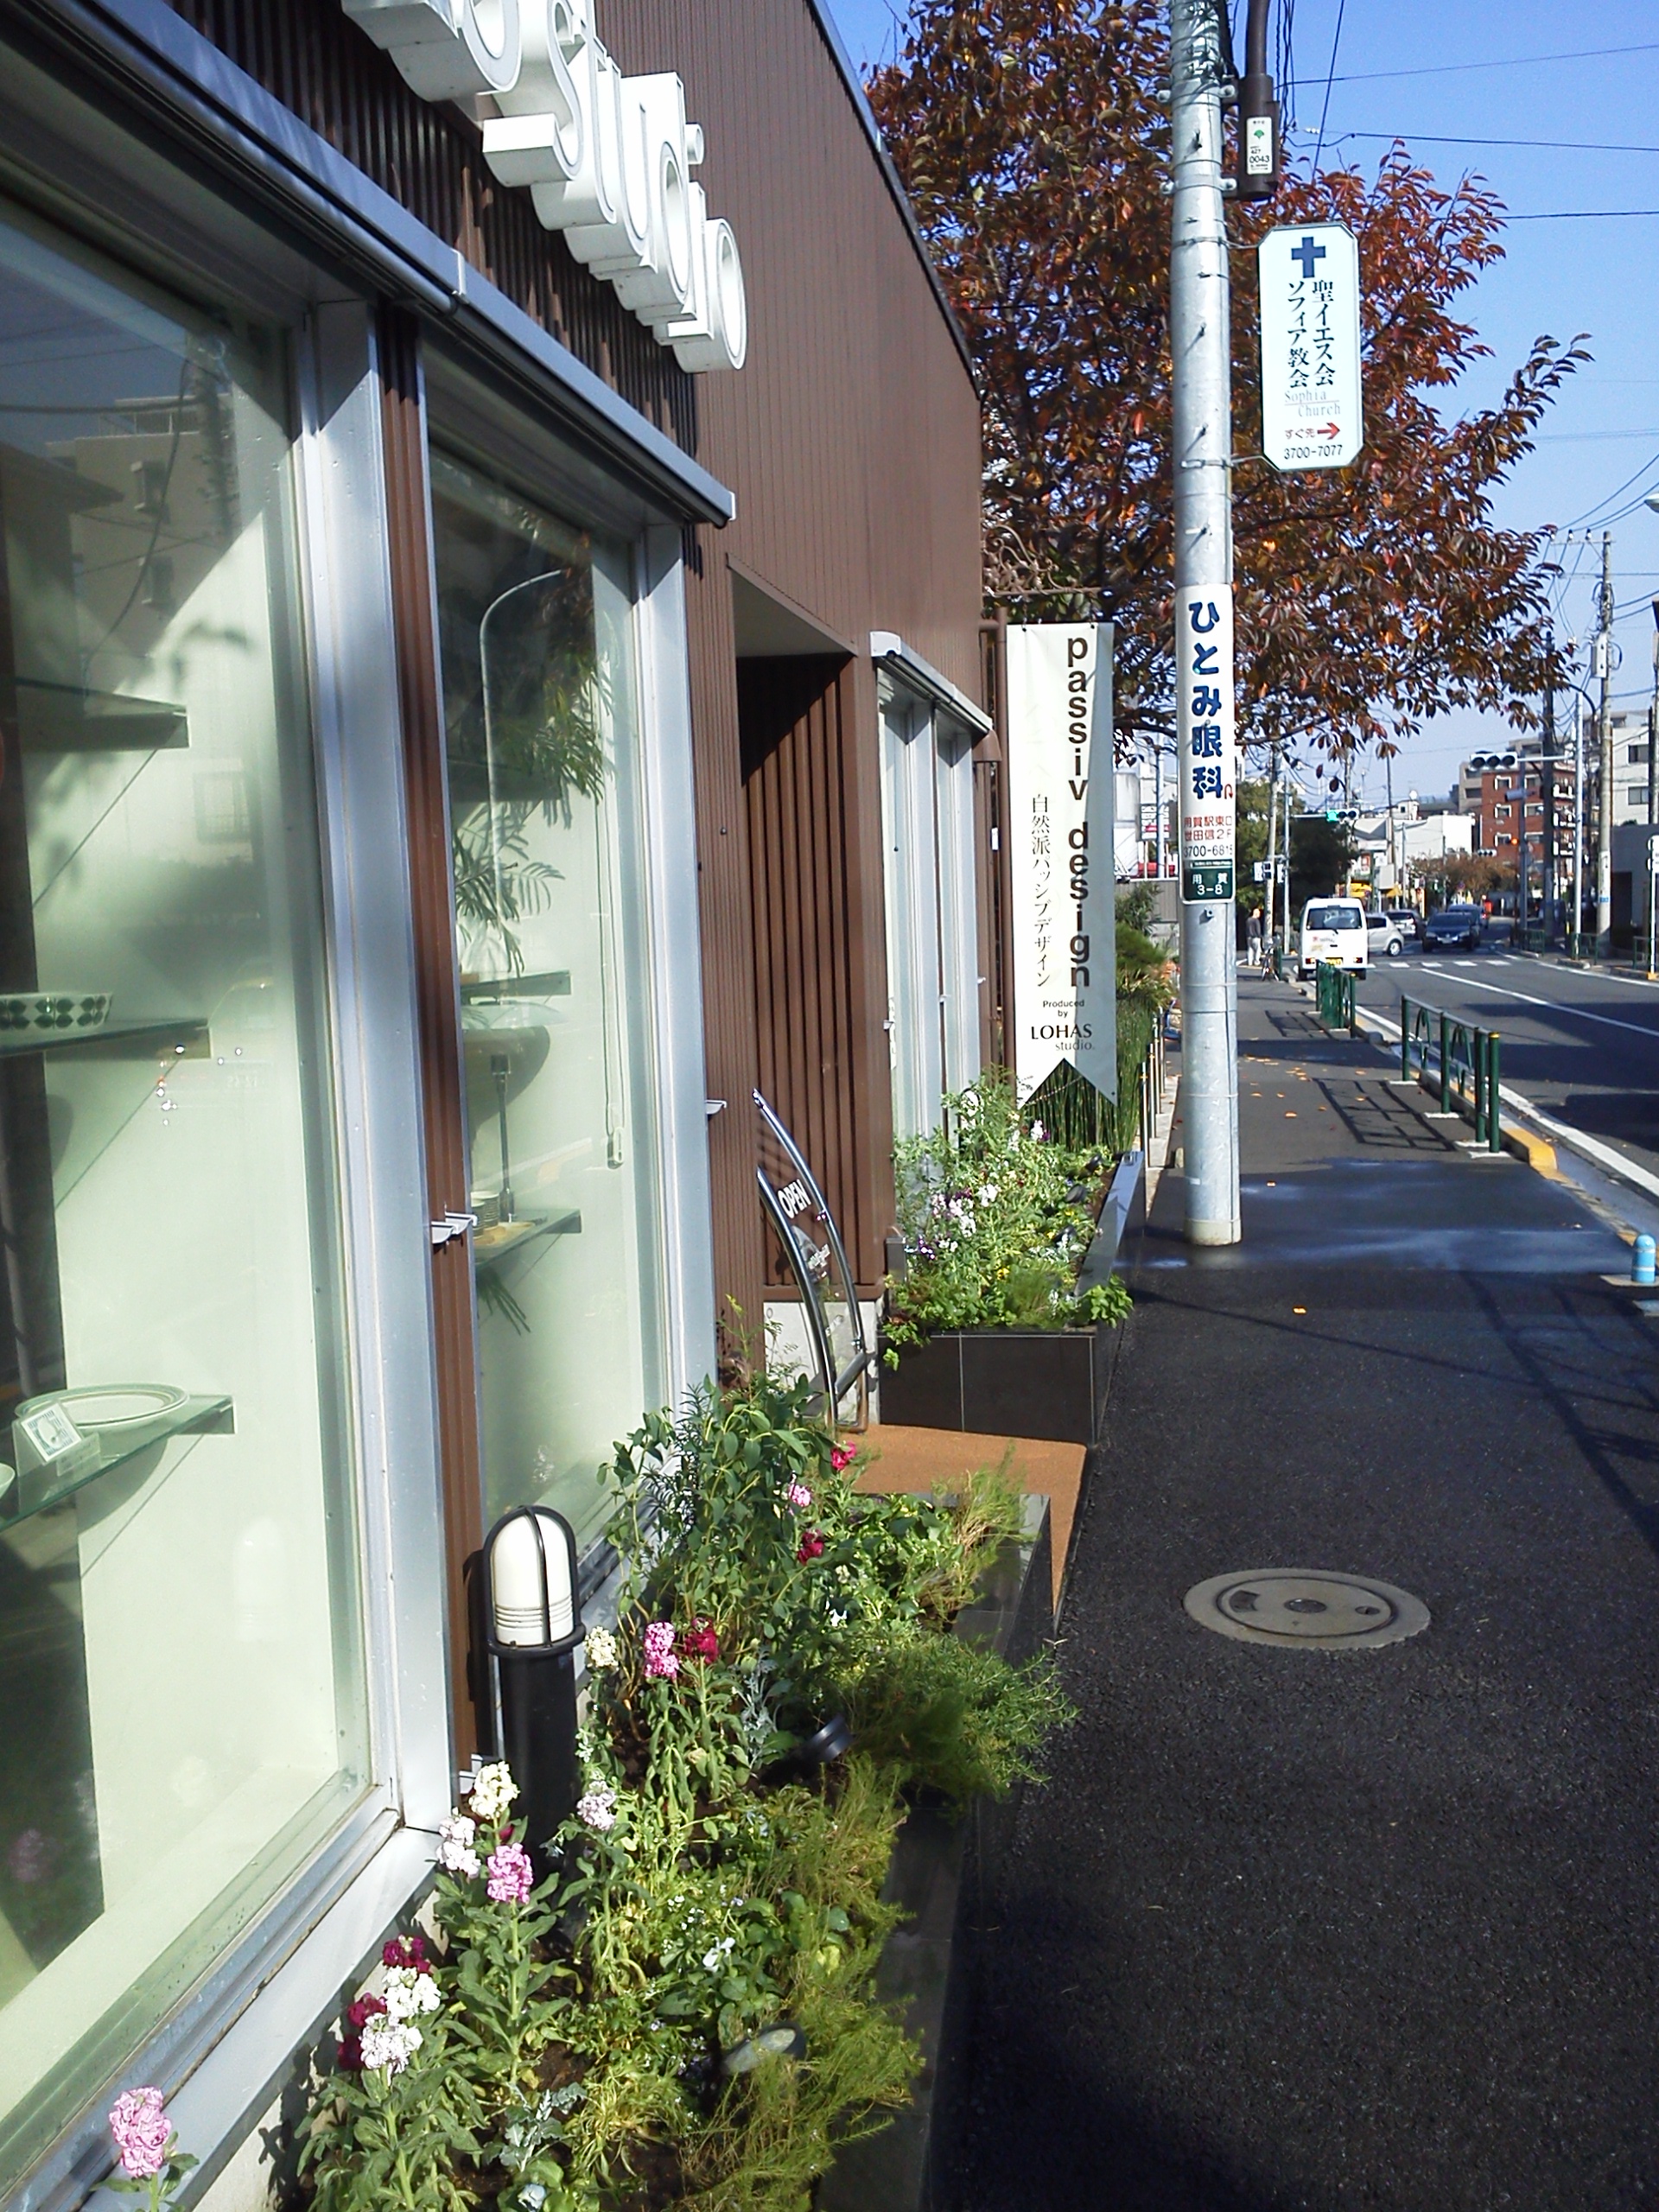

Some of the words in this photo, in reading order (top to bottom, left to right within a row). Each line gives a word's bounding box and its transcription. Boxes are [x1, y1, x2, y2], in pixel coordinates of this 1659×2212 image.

[1287, 281, 1310, 388] ソフィア教会
[1312, 280, 1336, 386] 聖イエス会
[1285, 389, 1326, 404] Sophia
[1298, 403, 1341, 416] Church
[1284, 444, 1343, 460] 3700-7077
[1189, 601, 1224, 800] ひとみ眼科
[1067, 637, 1089, 800] passiv
[1032, 793, 1052, 987] 自然派パッシブデザイン
[1197, 884, 1224, 895] 3-8
[1068, 821, 1090, 988] design
[1042, 999, 1085, 1007] Produced
[1058, 1009, 1069, 1018] by
[1031, 1023, 1093, 1039] LOHAS
[778, 1179, 812, 1219] OPEN
